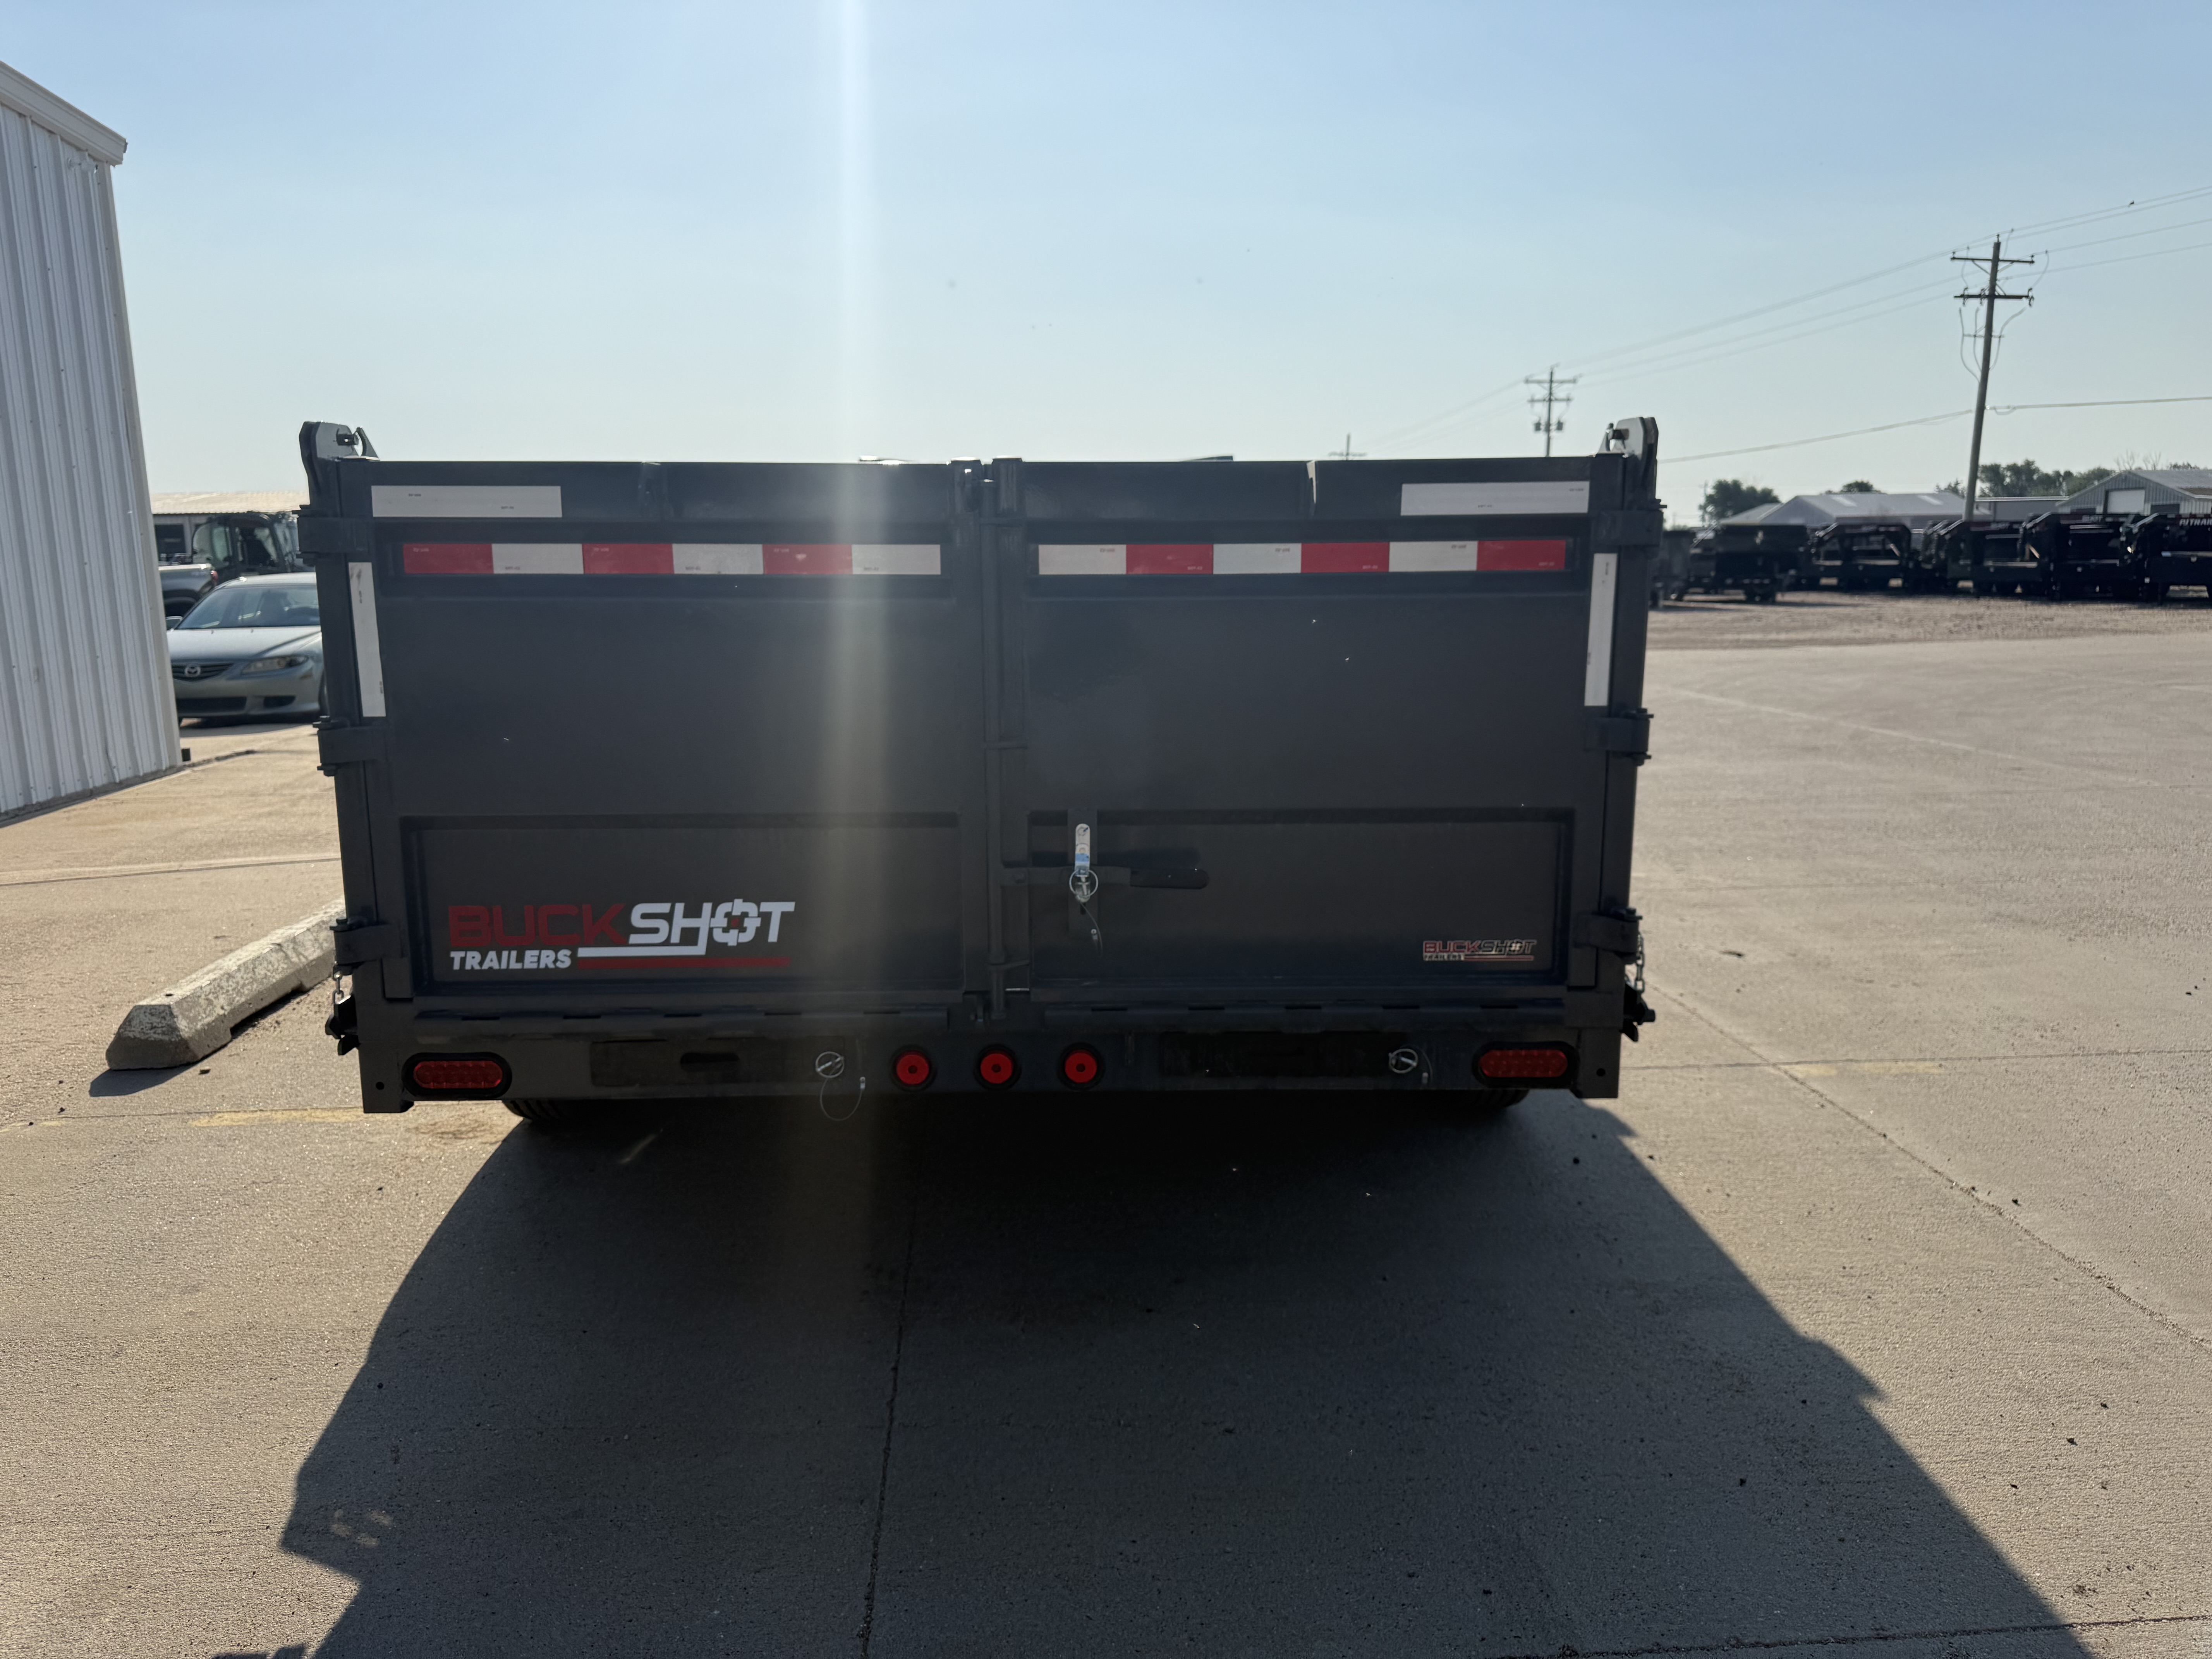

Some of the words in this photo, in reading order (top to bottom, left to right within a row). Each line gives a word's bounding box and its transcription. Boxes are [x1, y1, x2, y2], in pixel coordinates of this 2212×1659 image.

[448, 898, 796, 946] BUCKSHOT
[1423, 939, 1537, 955] BUCKSHOT
[450, 950, 572, 970] TRAILERS
